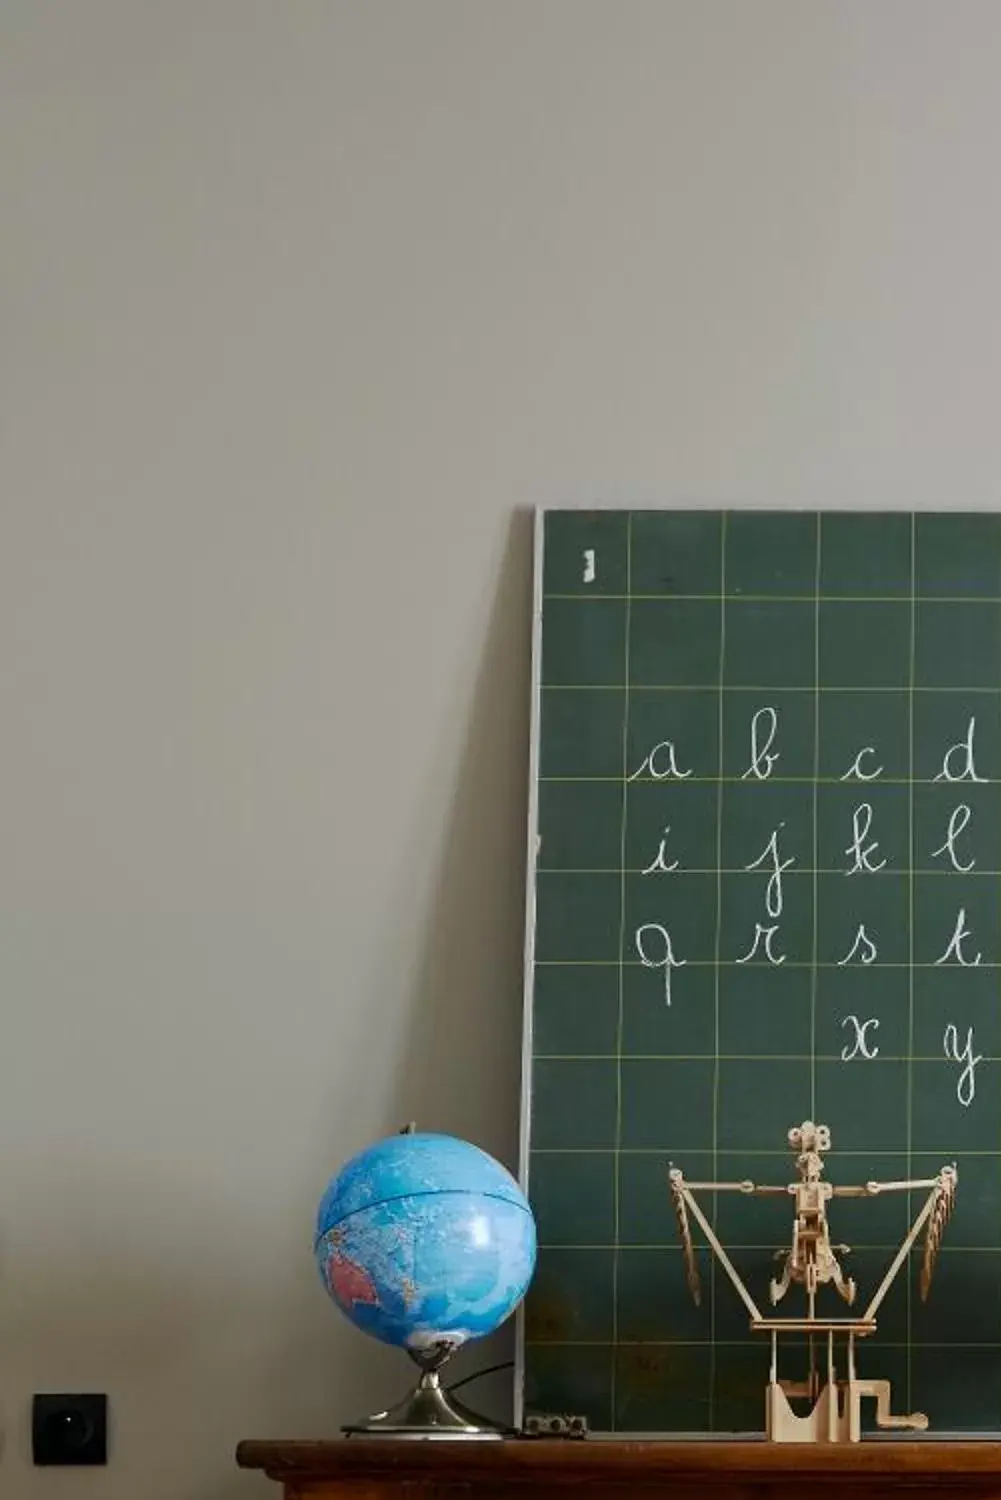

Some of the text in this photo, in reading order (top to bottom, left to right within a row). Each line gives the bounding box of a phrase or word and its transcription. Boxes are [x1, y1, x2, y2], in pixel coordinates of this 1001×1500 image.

[628, 742, 692, 781] a
[742, 707, 779, 780] b
[841, 747, 883, 781] c
[933, 716, 989, 782] d
[642, 826, 679, 874] i
[746, 822, 794, 917] j
[845, 803, 887, 876] k
[931, 805, 975, 871] l
[636, 923, 687, 1006] q
[736, 923, 785, 965] r
[838, 924, 878, 966] s
[934, 908, 982, 966] t
[841, 1015, 879, 1061] x
[944, 1024, 983, 1106] y
